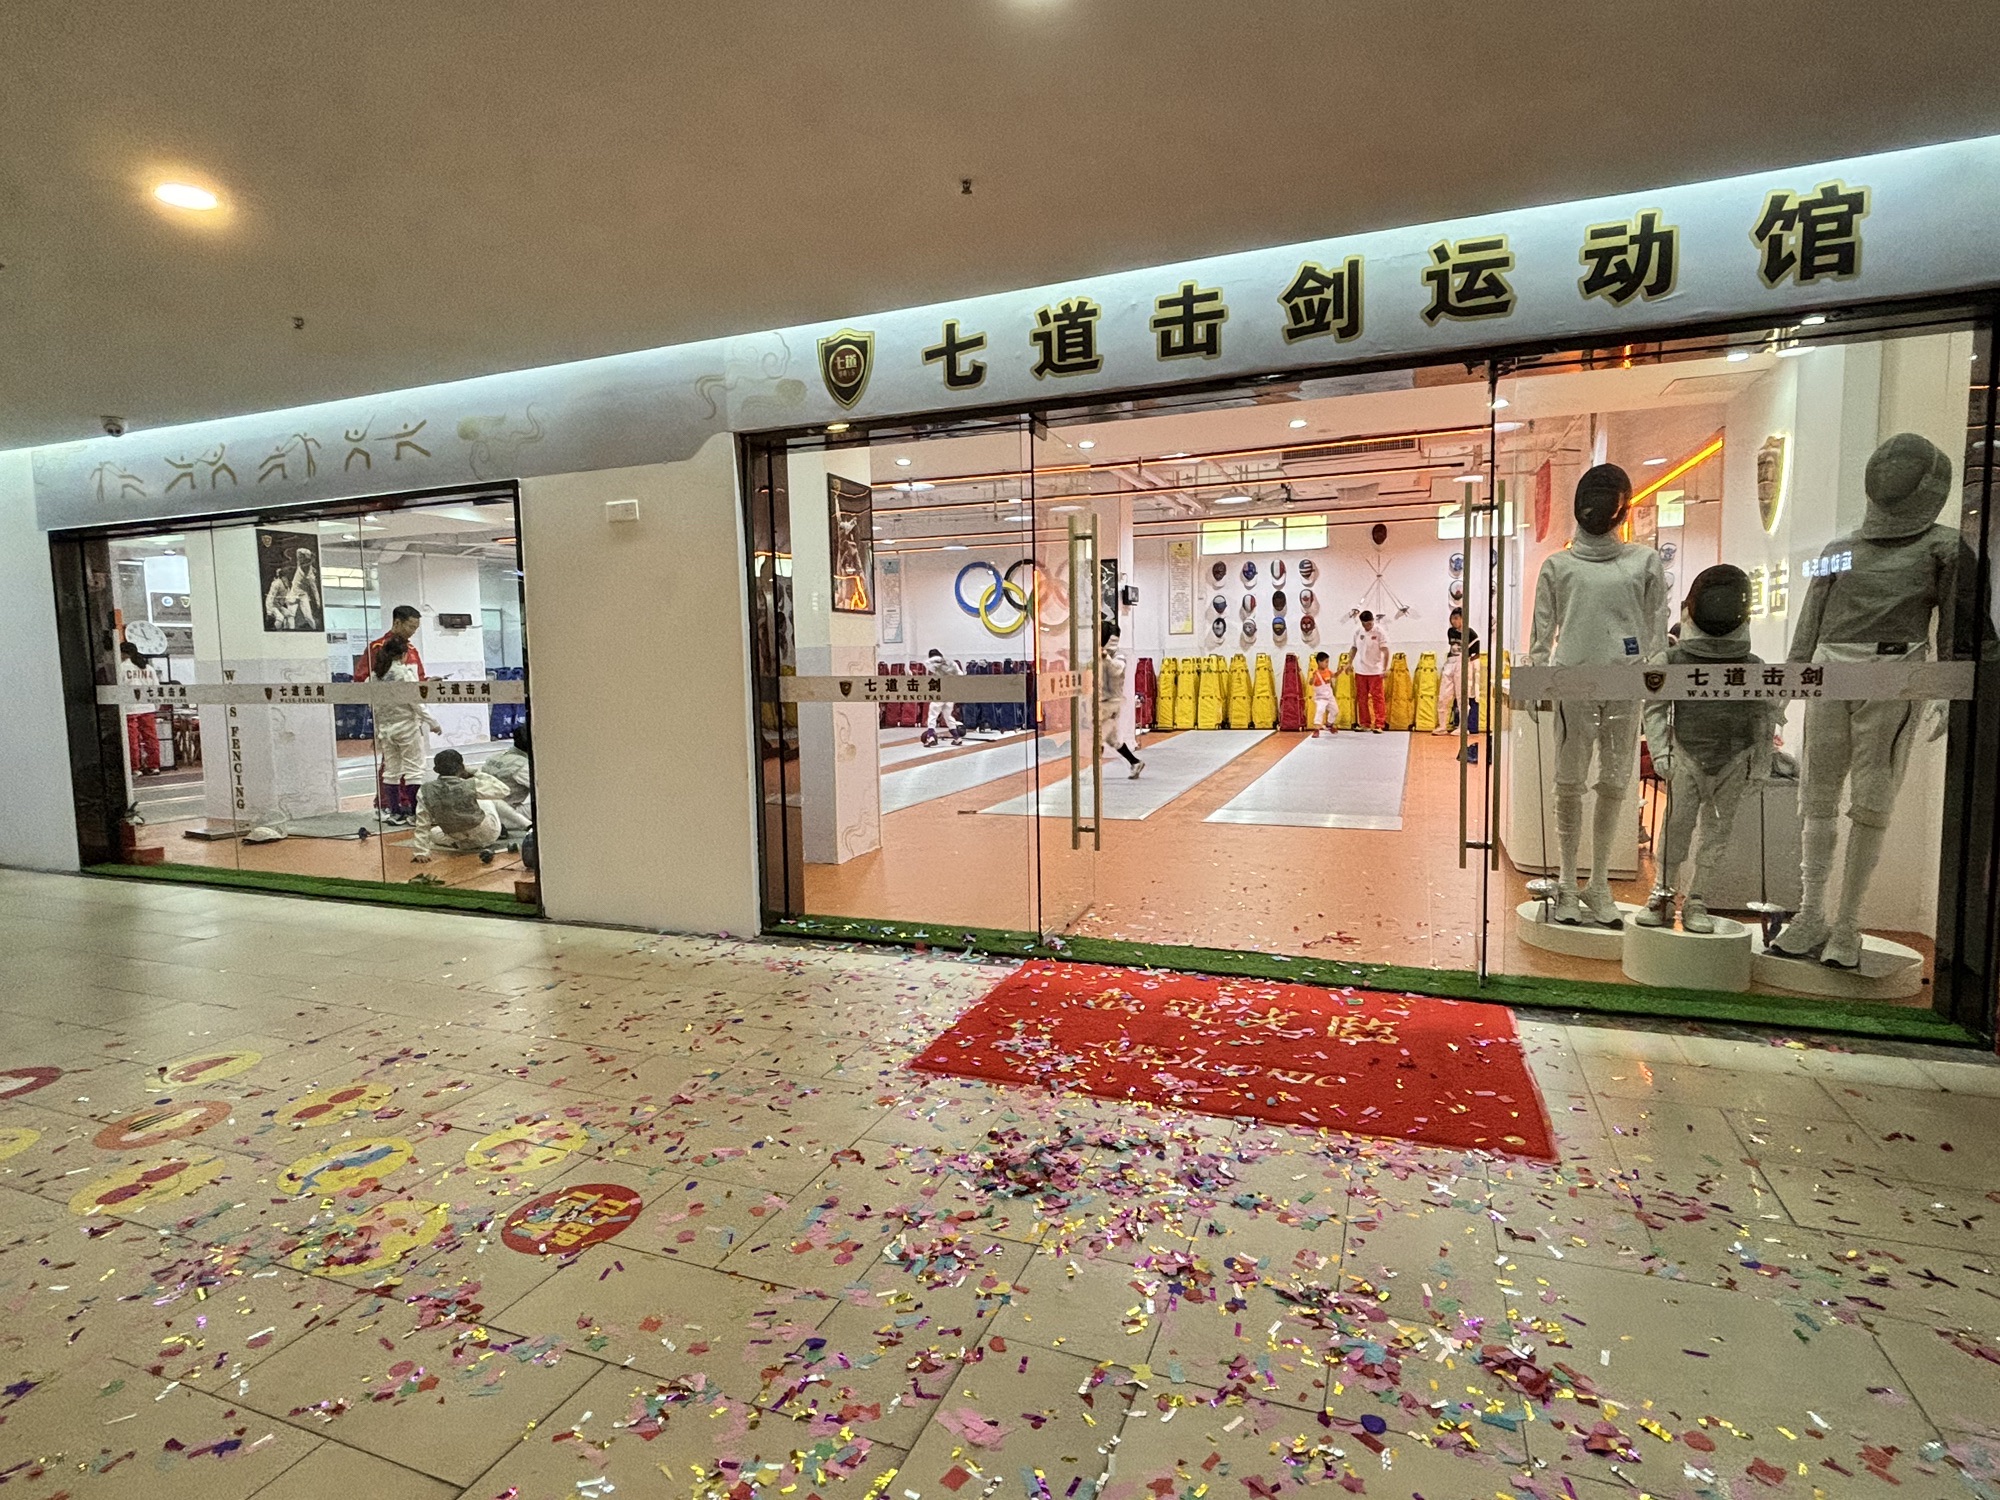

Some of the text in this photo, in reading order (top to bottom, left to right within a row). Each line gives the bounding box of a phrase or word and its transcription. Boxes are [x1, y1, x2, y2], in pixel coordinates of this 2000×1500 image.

[922, 180, 1871, 390] 七道击剑运动馆
[1687, 666, 1824, 686] 七道击剑
[279, 684, 325, 697] 七道击剑
[436, 682, 491, 695] 七道击剑
[864, 678, 941, 693] 七道击剑
[1687, 689, 1823, 698] WAYS FENCING
[230, 726, 245, 810] FENCING
